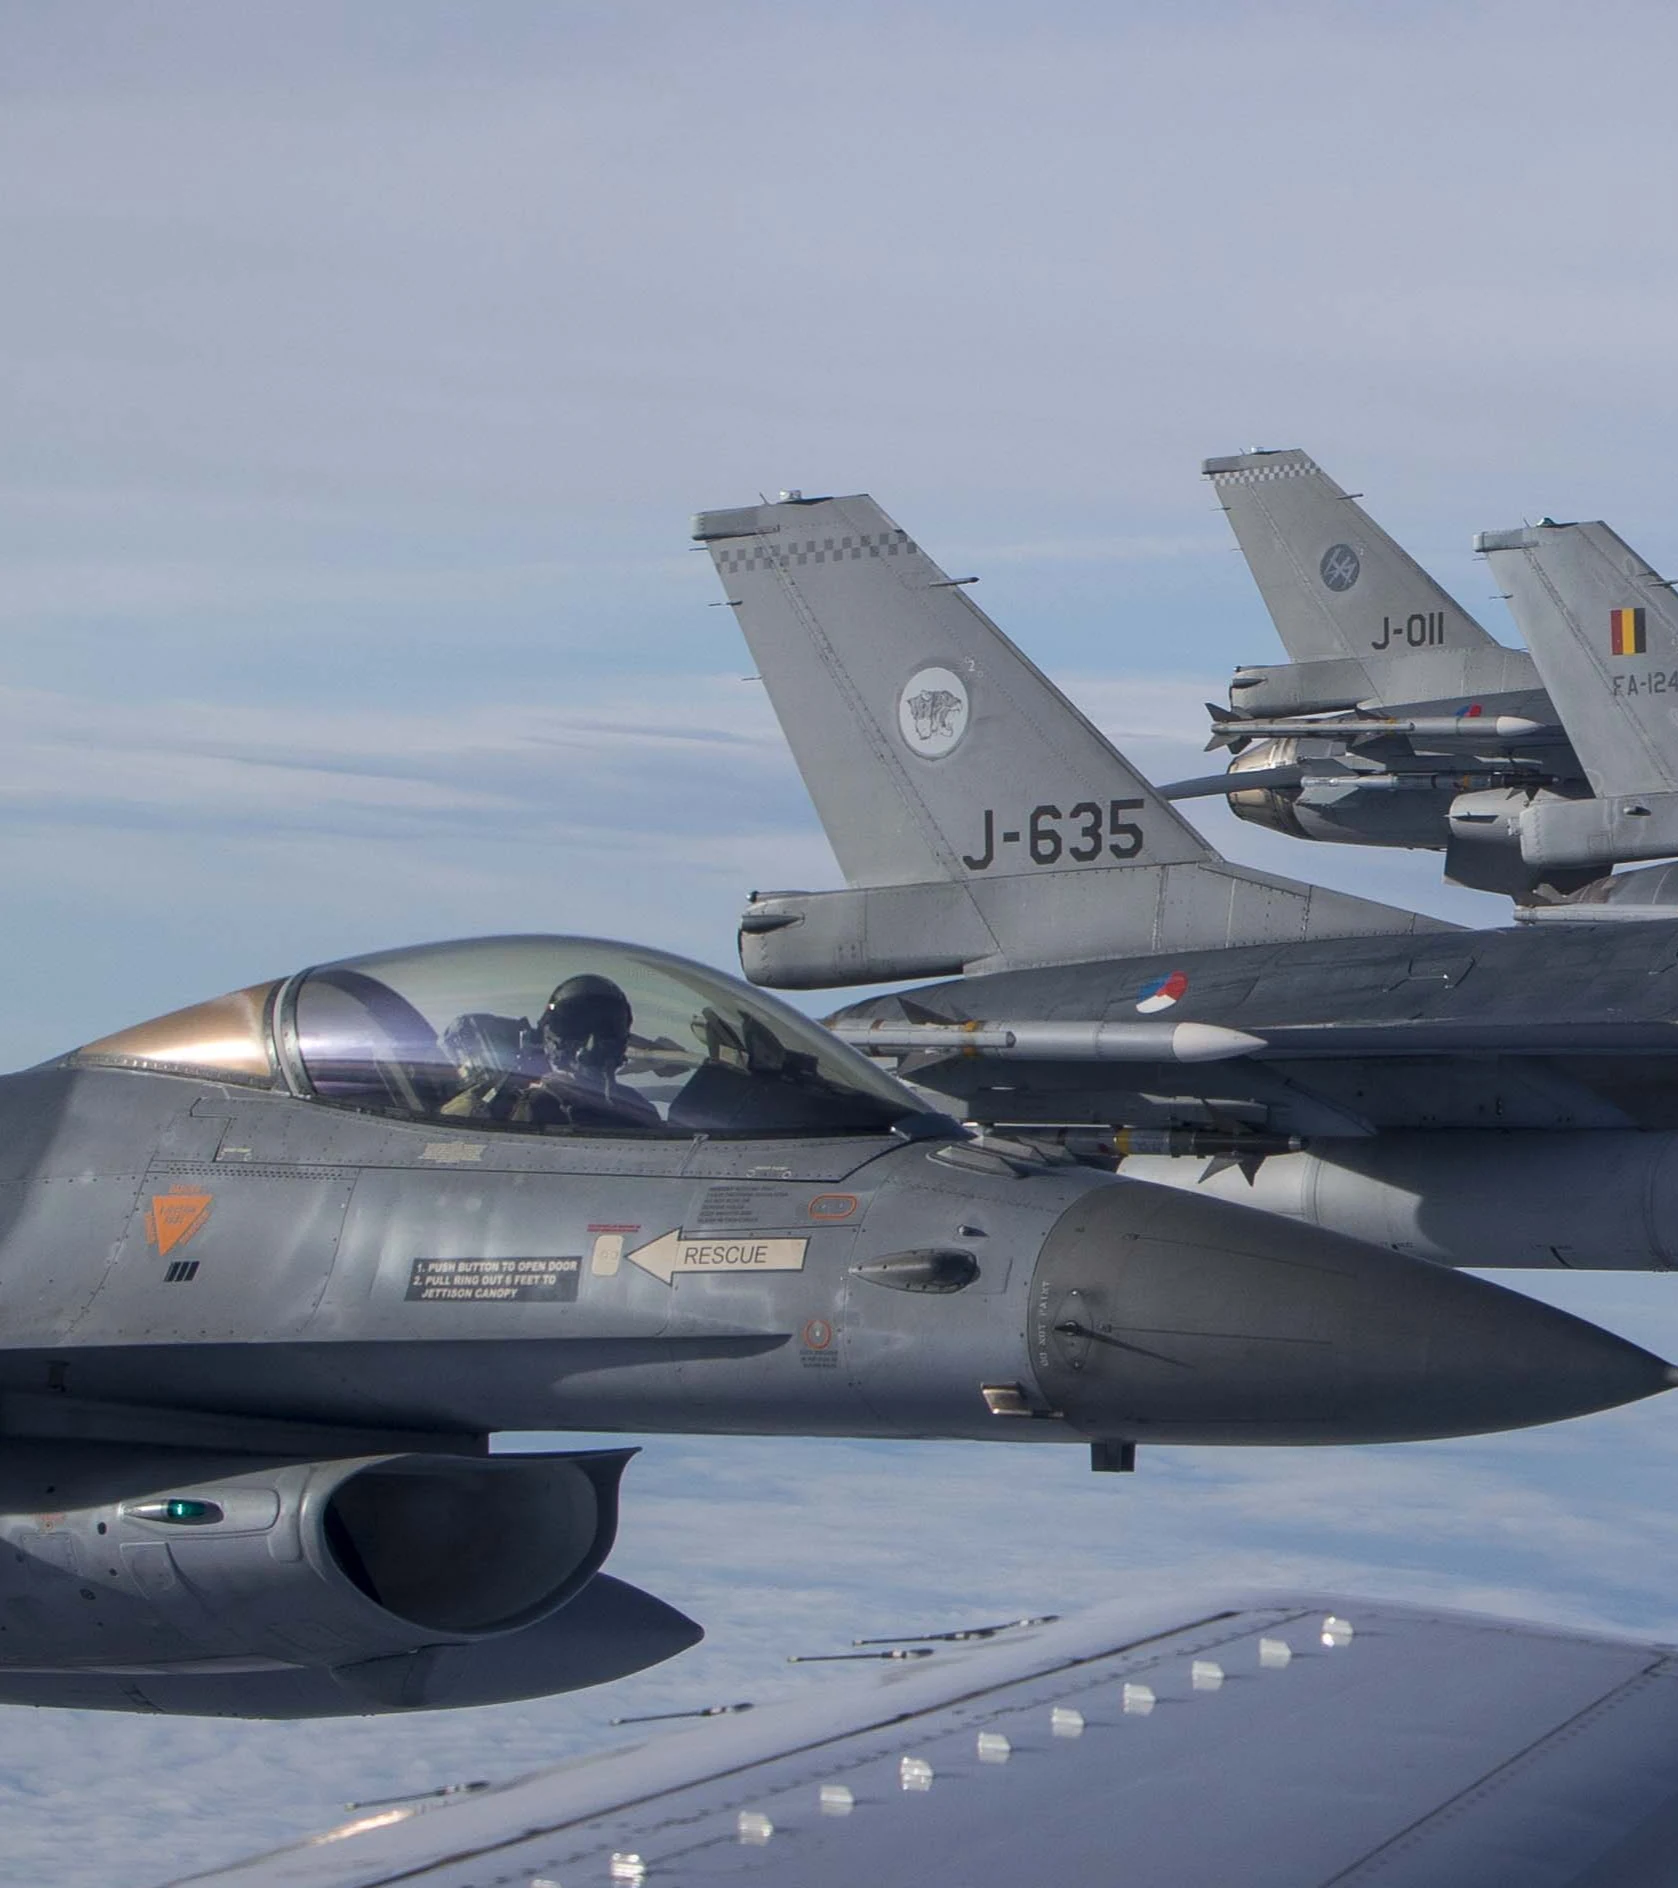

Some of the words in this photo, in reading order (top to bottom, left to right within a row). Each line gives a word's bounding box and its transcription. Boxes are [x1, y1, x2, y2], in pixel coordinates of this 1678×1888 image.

[1371, 611, 1444, 650] J-011
[962, 798, 1145, 871] J-635
[428, 1262, 455, 1272] PUSH
[457, 1261, 499, 1272] BUTTON
[502, 1261, 516, 1272] TO
[518, 1261, 546, 1271] OPEN
[548, 1260, 578, 1271] DOOR
[683, 1245, 769, 1265] RESCUE
[424, 1275, 451, 1286] PULL
[453, 1275, 480, 1285] RING
[481, 1275, 503, 1285] OUT
[514, 1274, 540, 1285] FEET
[542, 1274, 557, 1284] TO
[421, 1288, 472, 1298] JETTISON
[474, 1288, 519, 1298] CANOPY
[1039, 1280, 1051, 1317] PAINT
[1037, 1323, 1049, 1347] NOT
